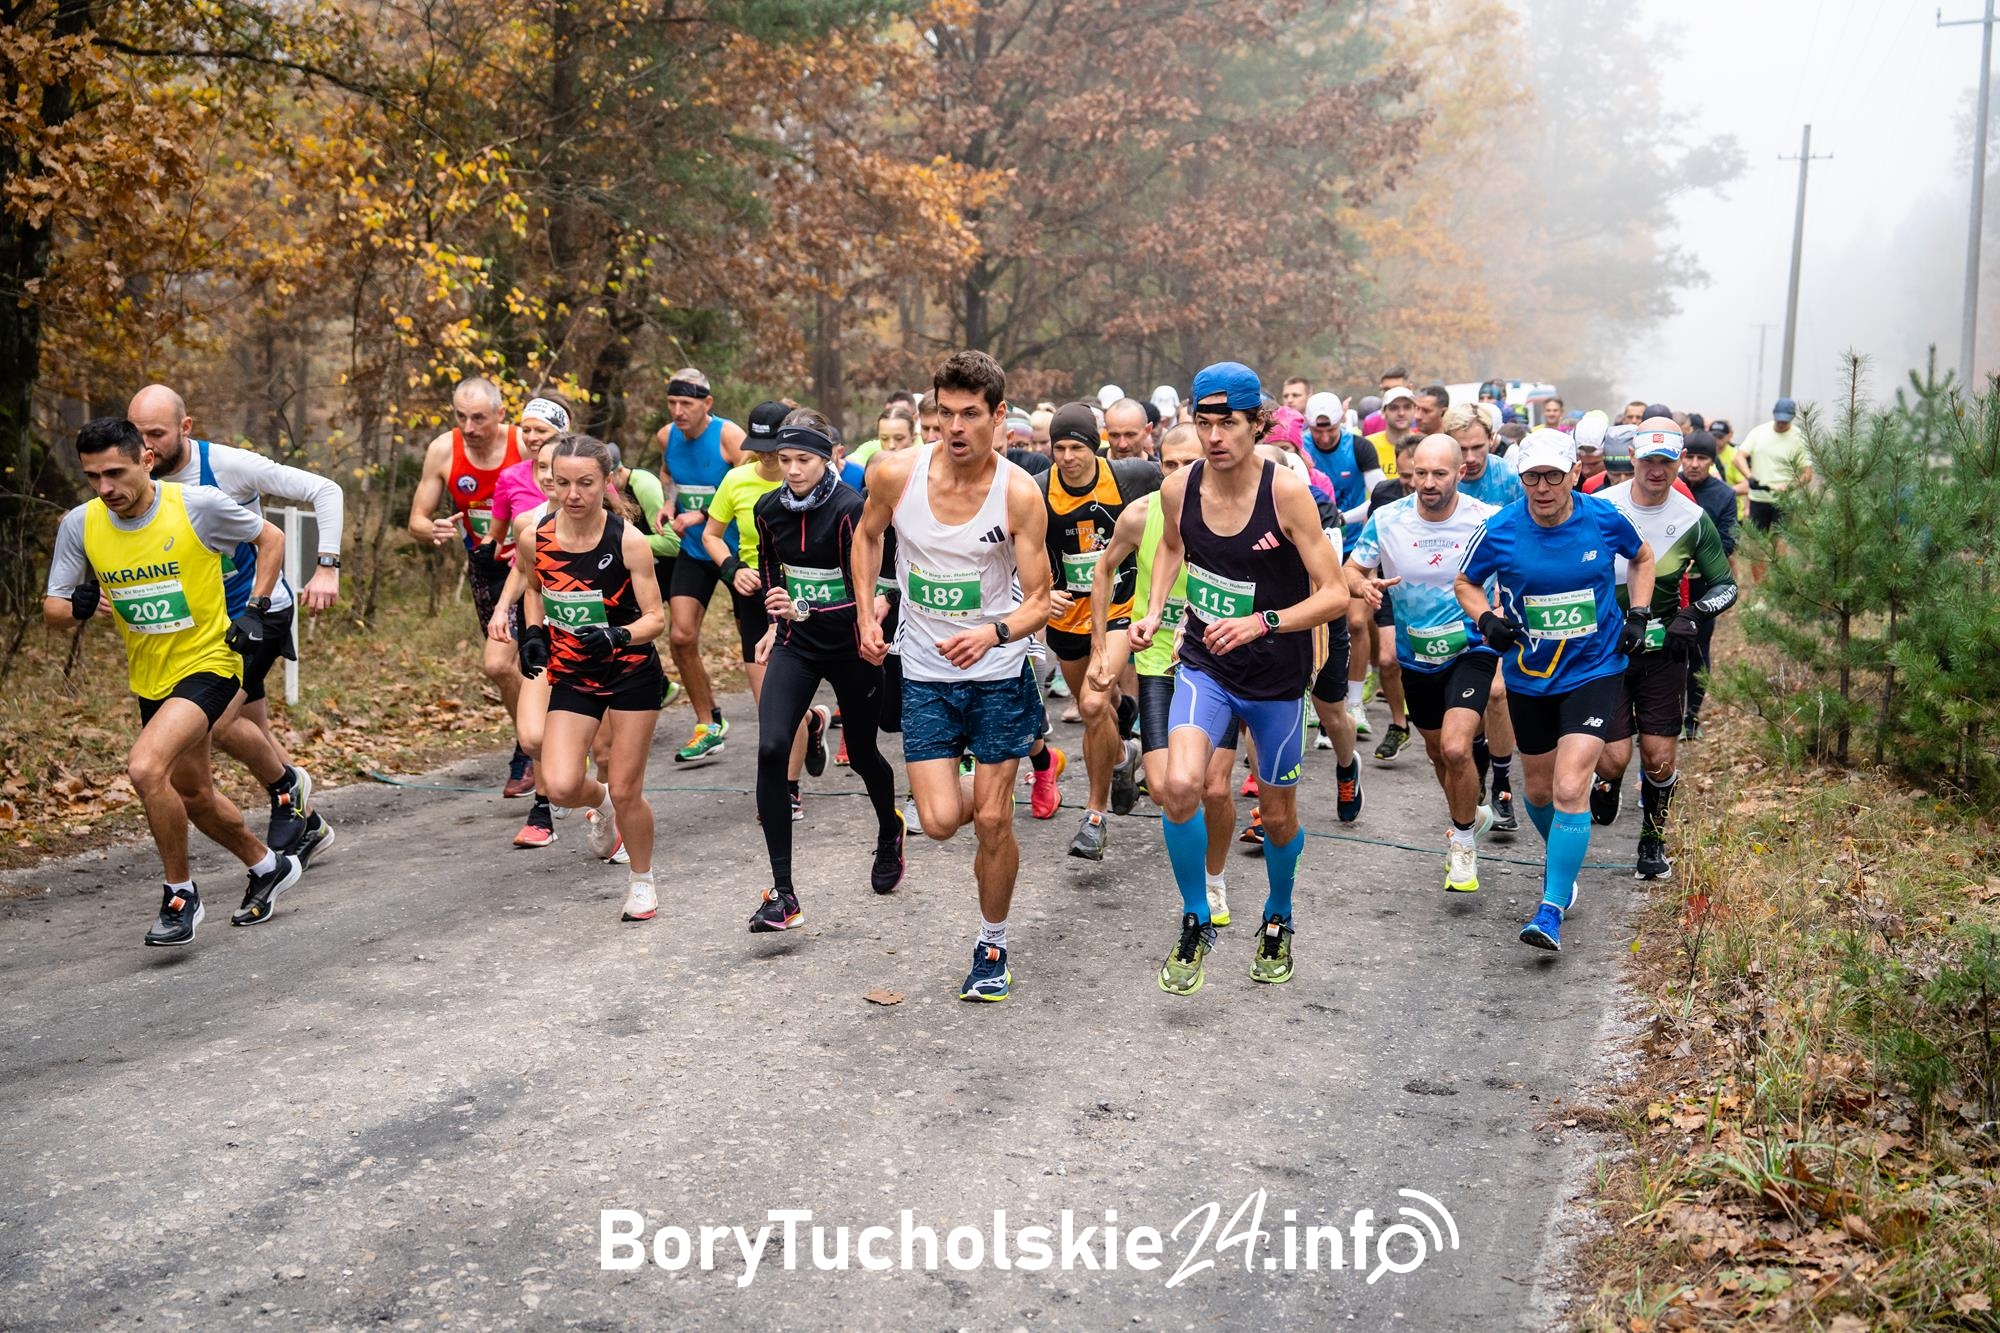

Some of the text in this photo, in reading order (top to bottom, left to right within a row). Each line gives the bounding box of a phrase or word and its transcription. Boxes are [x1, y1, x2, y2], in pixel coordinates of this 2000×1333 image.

[98, 561, 181, 584] UKRAINE
[794, 583, 831, 603] 134
[921, 585, 963, 606] 189
[1198, 587, 1236, 616] 115
[129, 600, 174, 621] 202
[553, 605, 592, 623] 192
[1540, 607, 1583, 628] 126
[1426, 639, 1450, 654] 68
